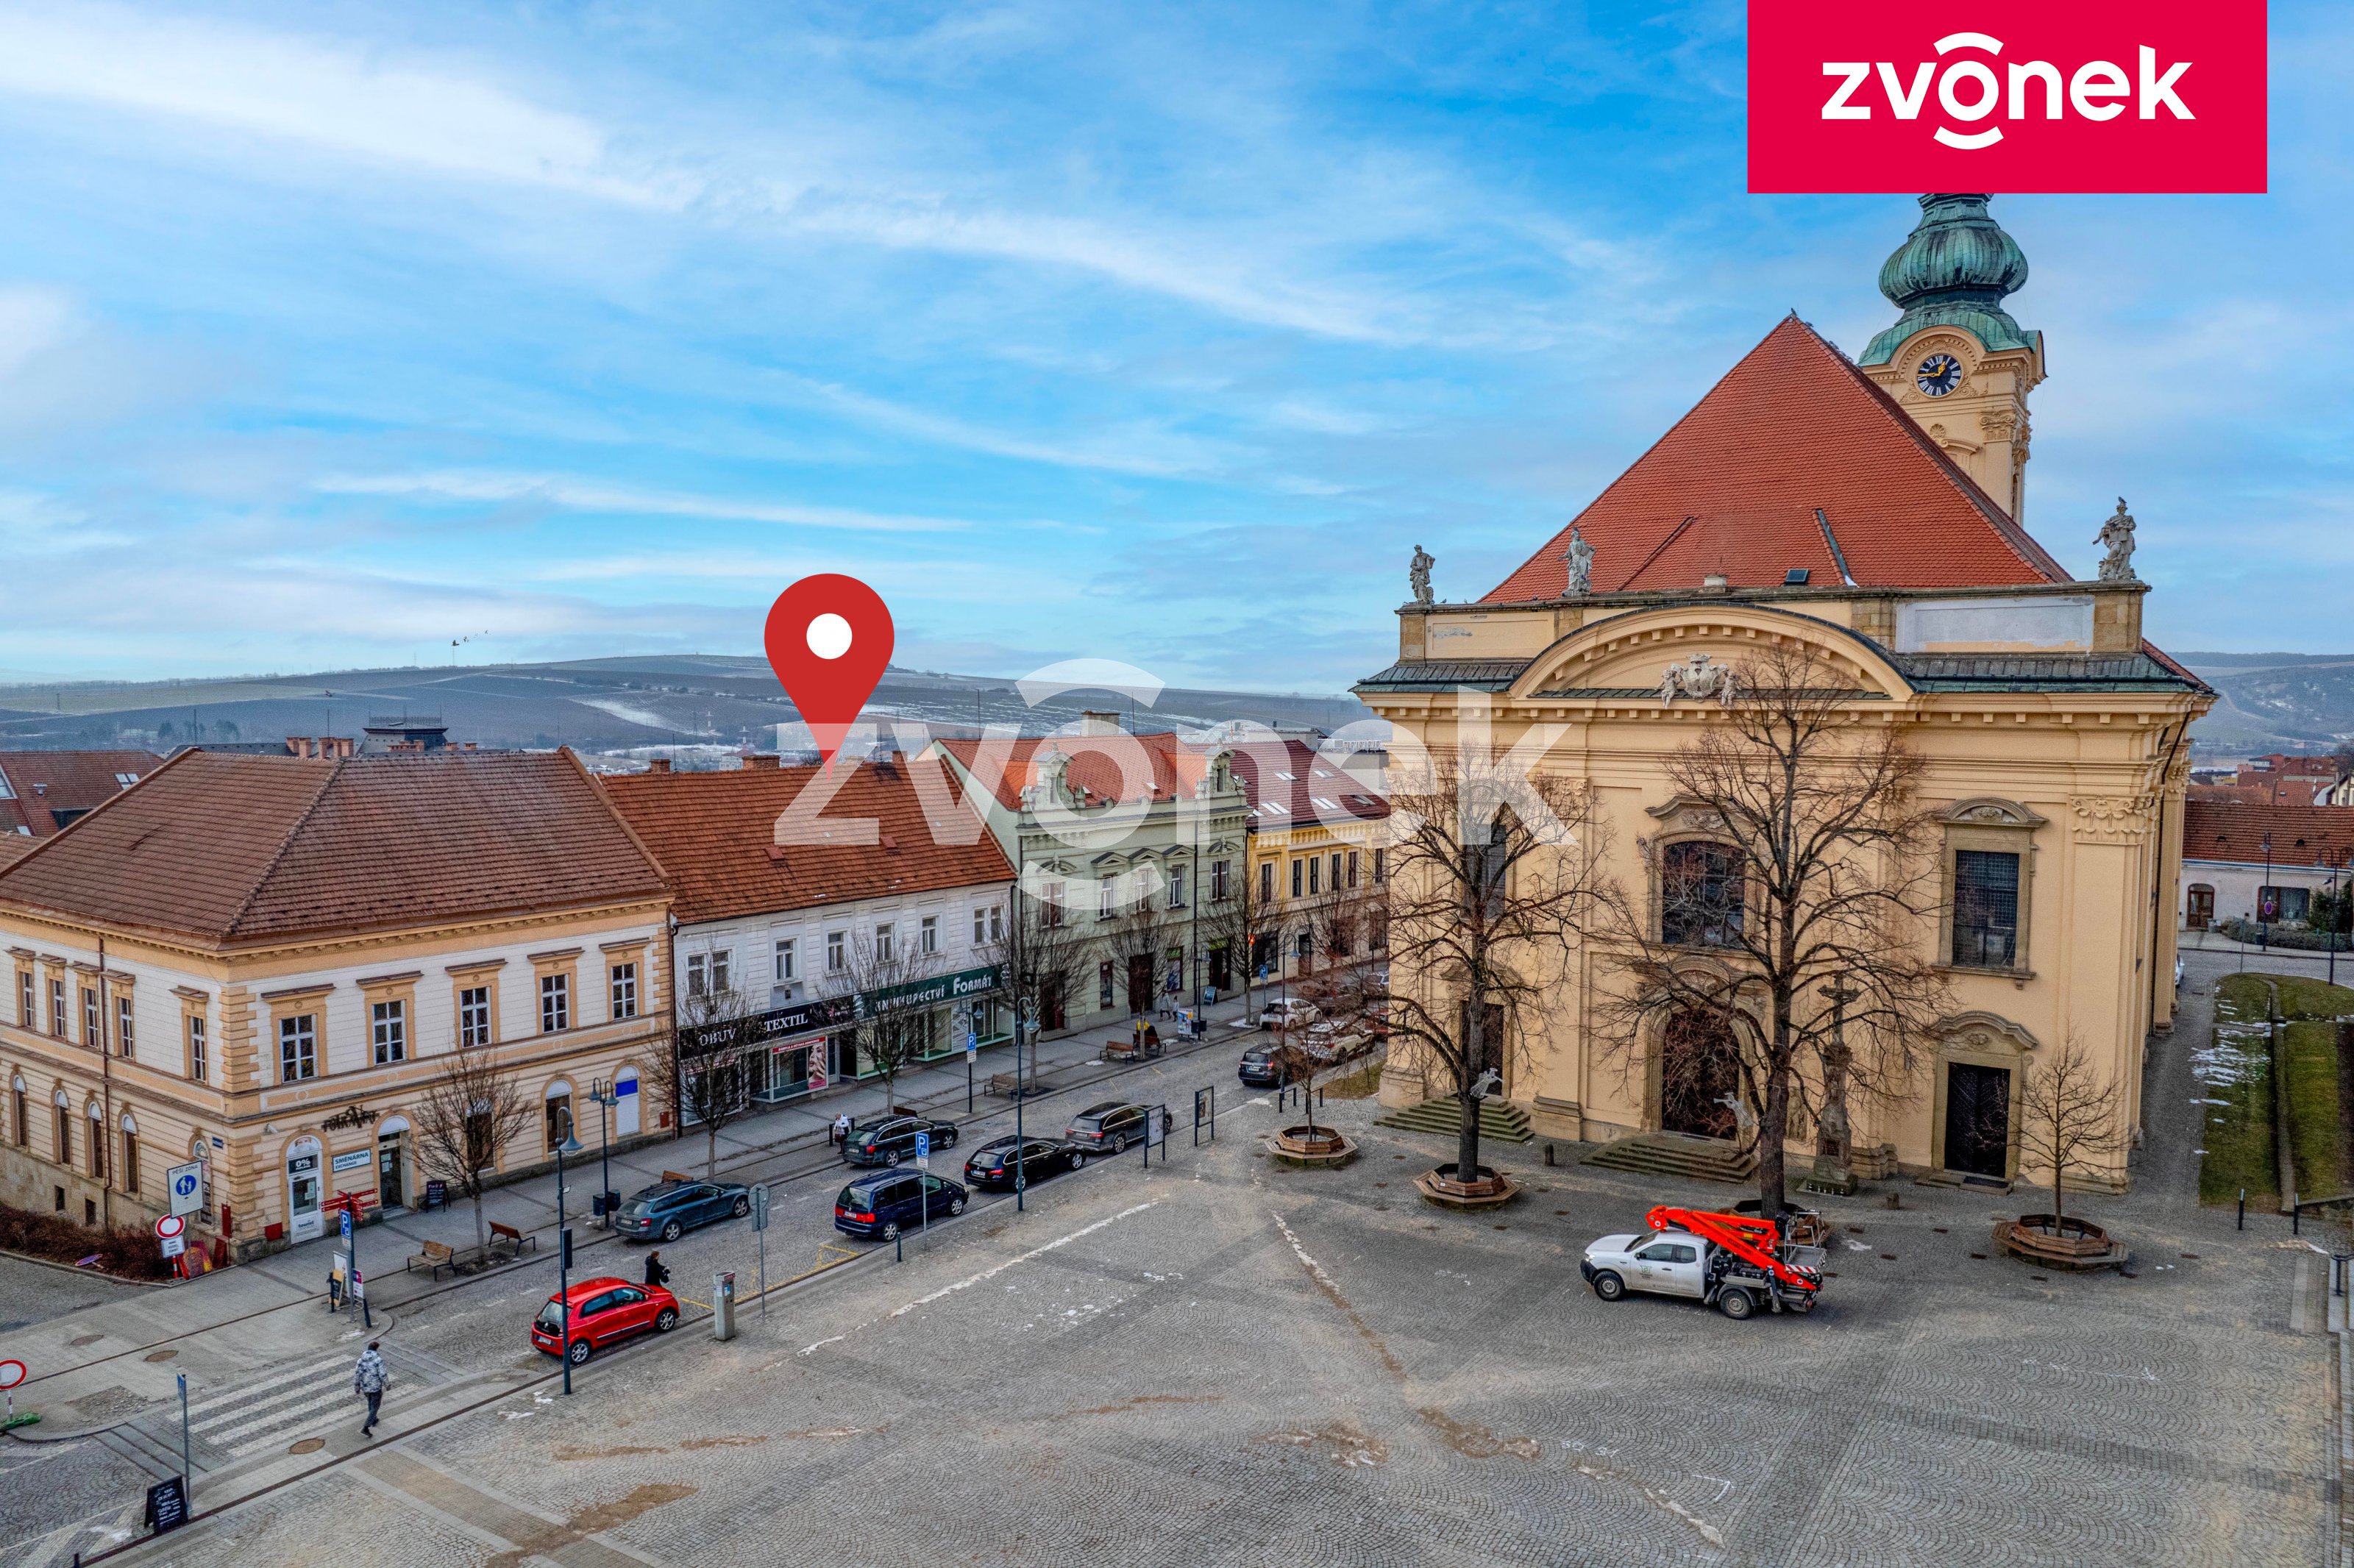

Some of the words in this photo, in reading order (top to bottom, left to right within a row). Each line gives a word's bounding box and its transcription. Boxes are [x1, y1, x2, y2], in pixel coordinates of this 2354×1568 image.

[699, 1029, 736, 1047] OBUV
[764, 1013, 808, 1031] TEXTIL
[968, 1036, 975, 1047] P
[918, 1136, 925, 1150] P
[296, 1158, 310, 1167] 0%
[335, 1161, 357, 1169] EXCHANGE
[342, 1215, 348, 1227] P
